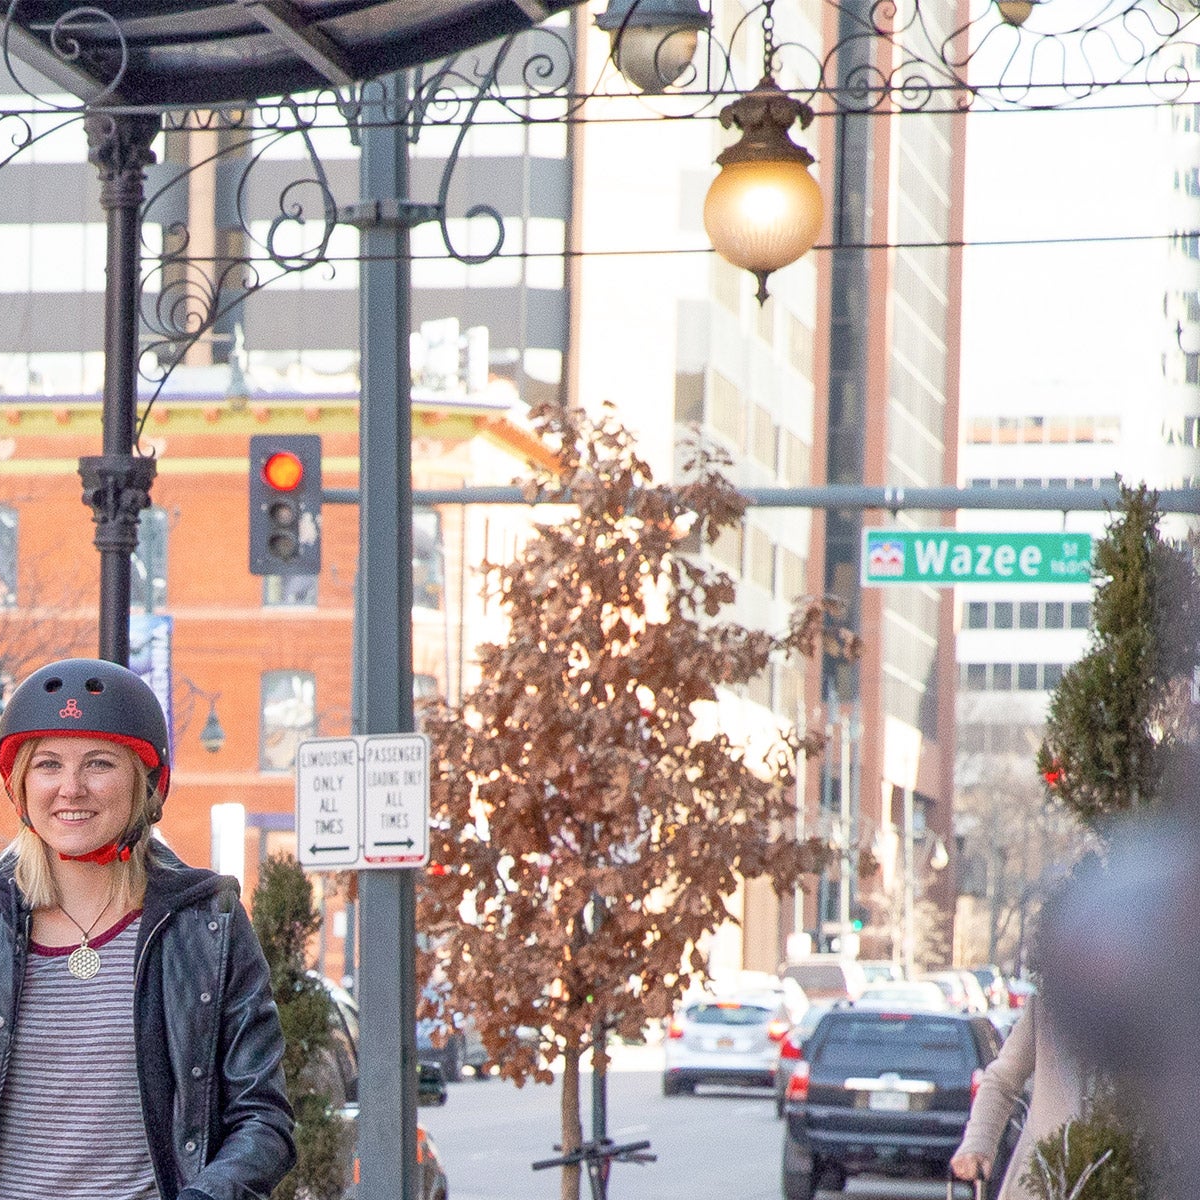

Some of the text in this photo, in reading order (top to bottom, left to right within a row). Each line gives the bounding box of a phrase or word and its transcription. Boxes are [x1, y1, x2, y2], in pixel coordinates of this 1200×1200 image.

[914, 539, 1043, 576] Wazee
[302, 750, 354, 768] LIMOUSINE
[367, 746, 422, 763] PASSENGER
[312, 776, 343, 792] ONLY
[368, 771, 422, 787] LOADING ONLY
[319, 797, 338, 813] ALL
[385, 792, 404, 807] ALL
[314, 818, 343, 835] TIMES
[381, 812, 409, 829] TIMES
